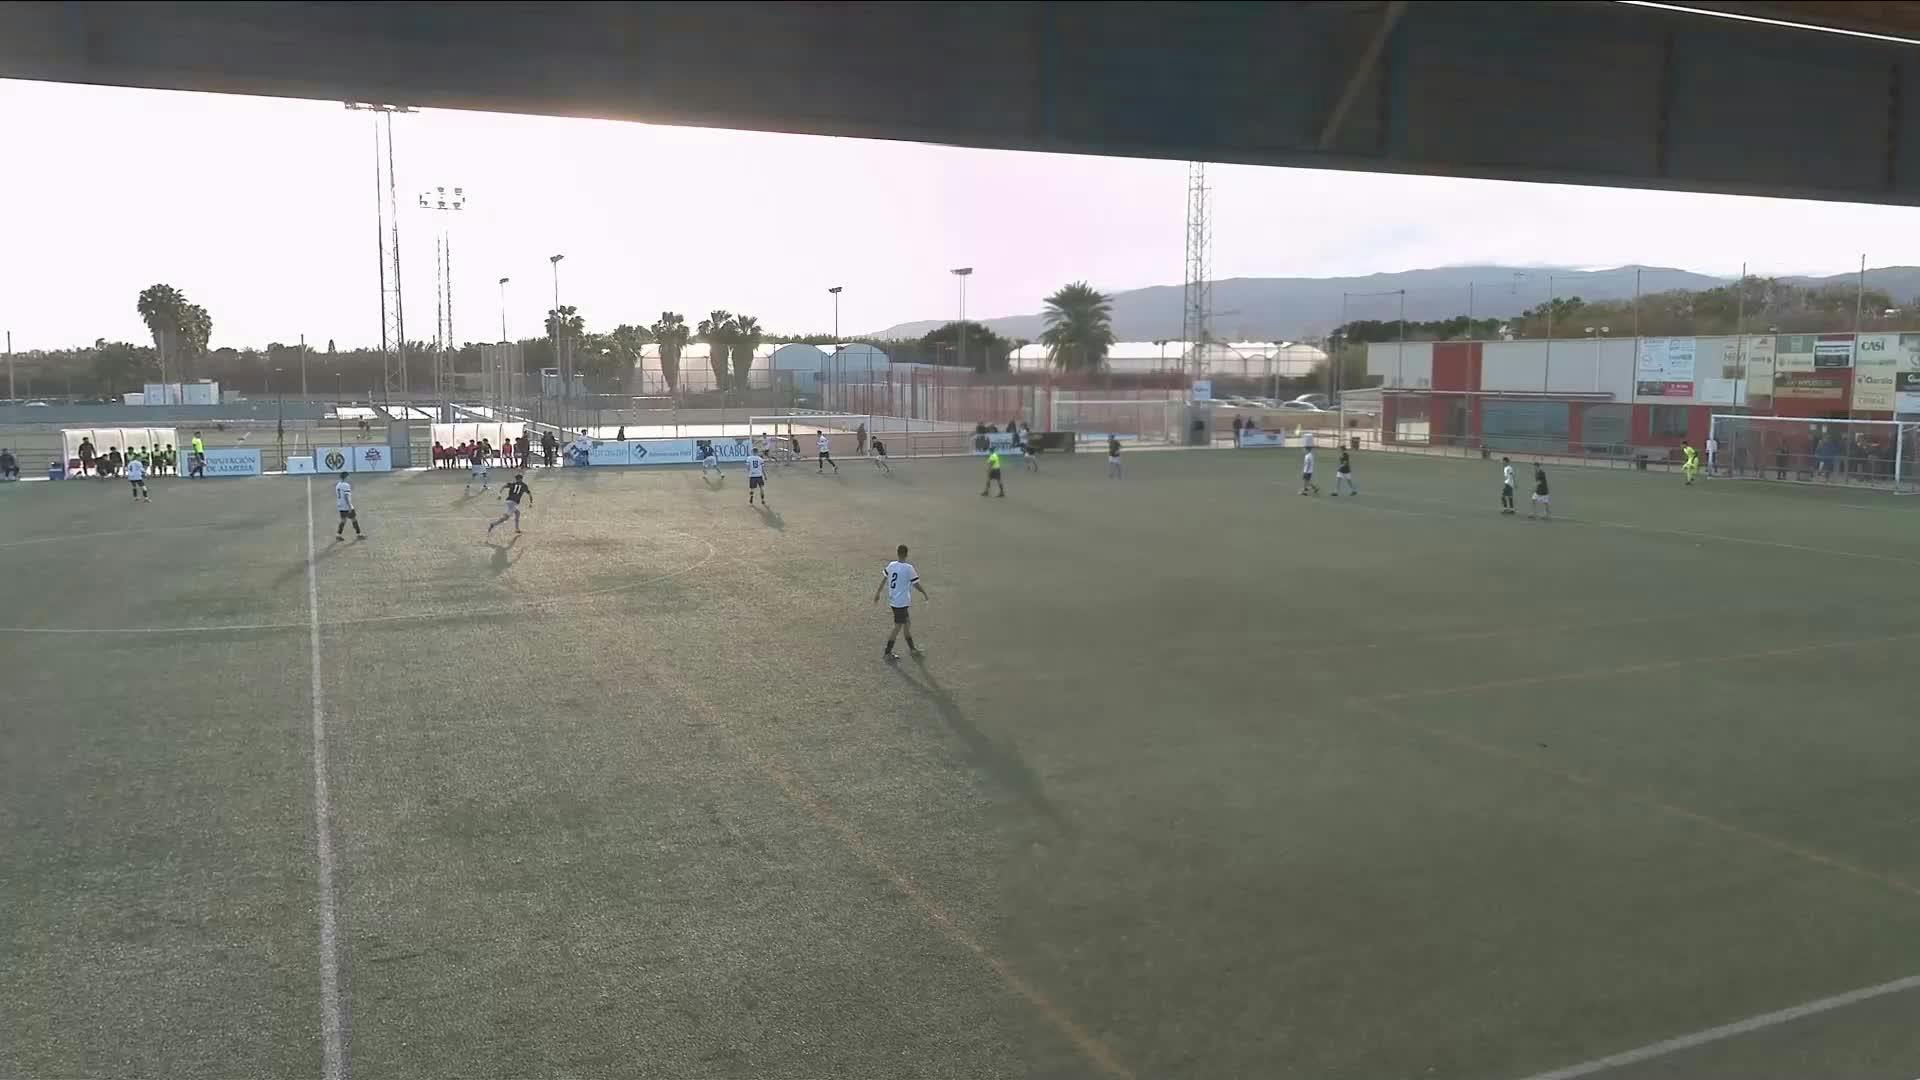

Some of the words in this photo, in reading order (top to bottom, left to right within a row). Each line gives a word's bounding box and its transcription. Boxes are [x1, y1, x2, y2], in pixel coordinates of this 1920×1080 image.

[1861, 340, 1885, 351] CASI
[513, 484, 521, 495] 11
[890, 572, 898, 589] 2
